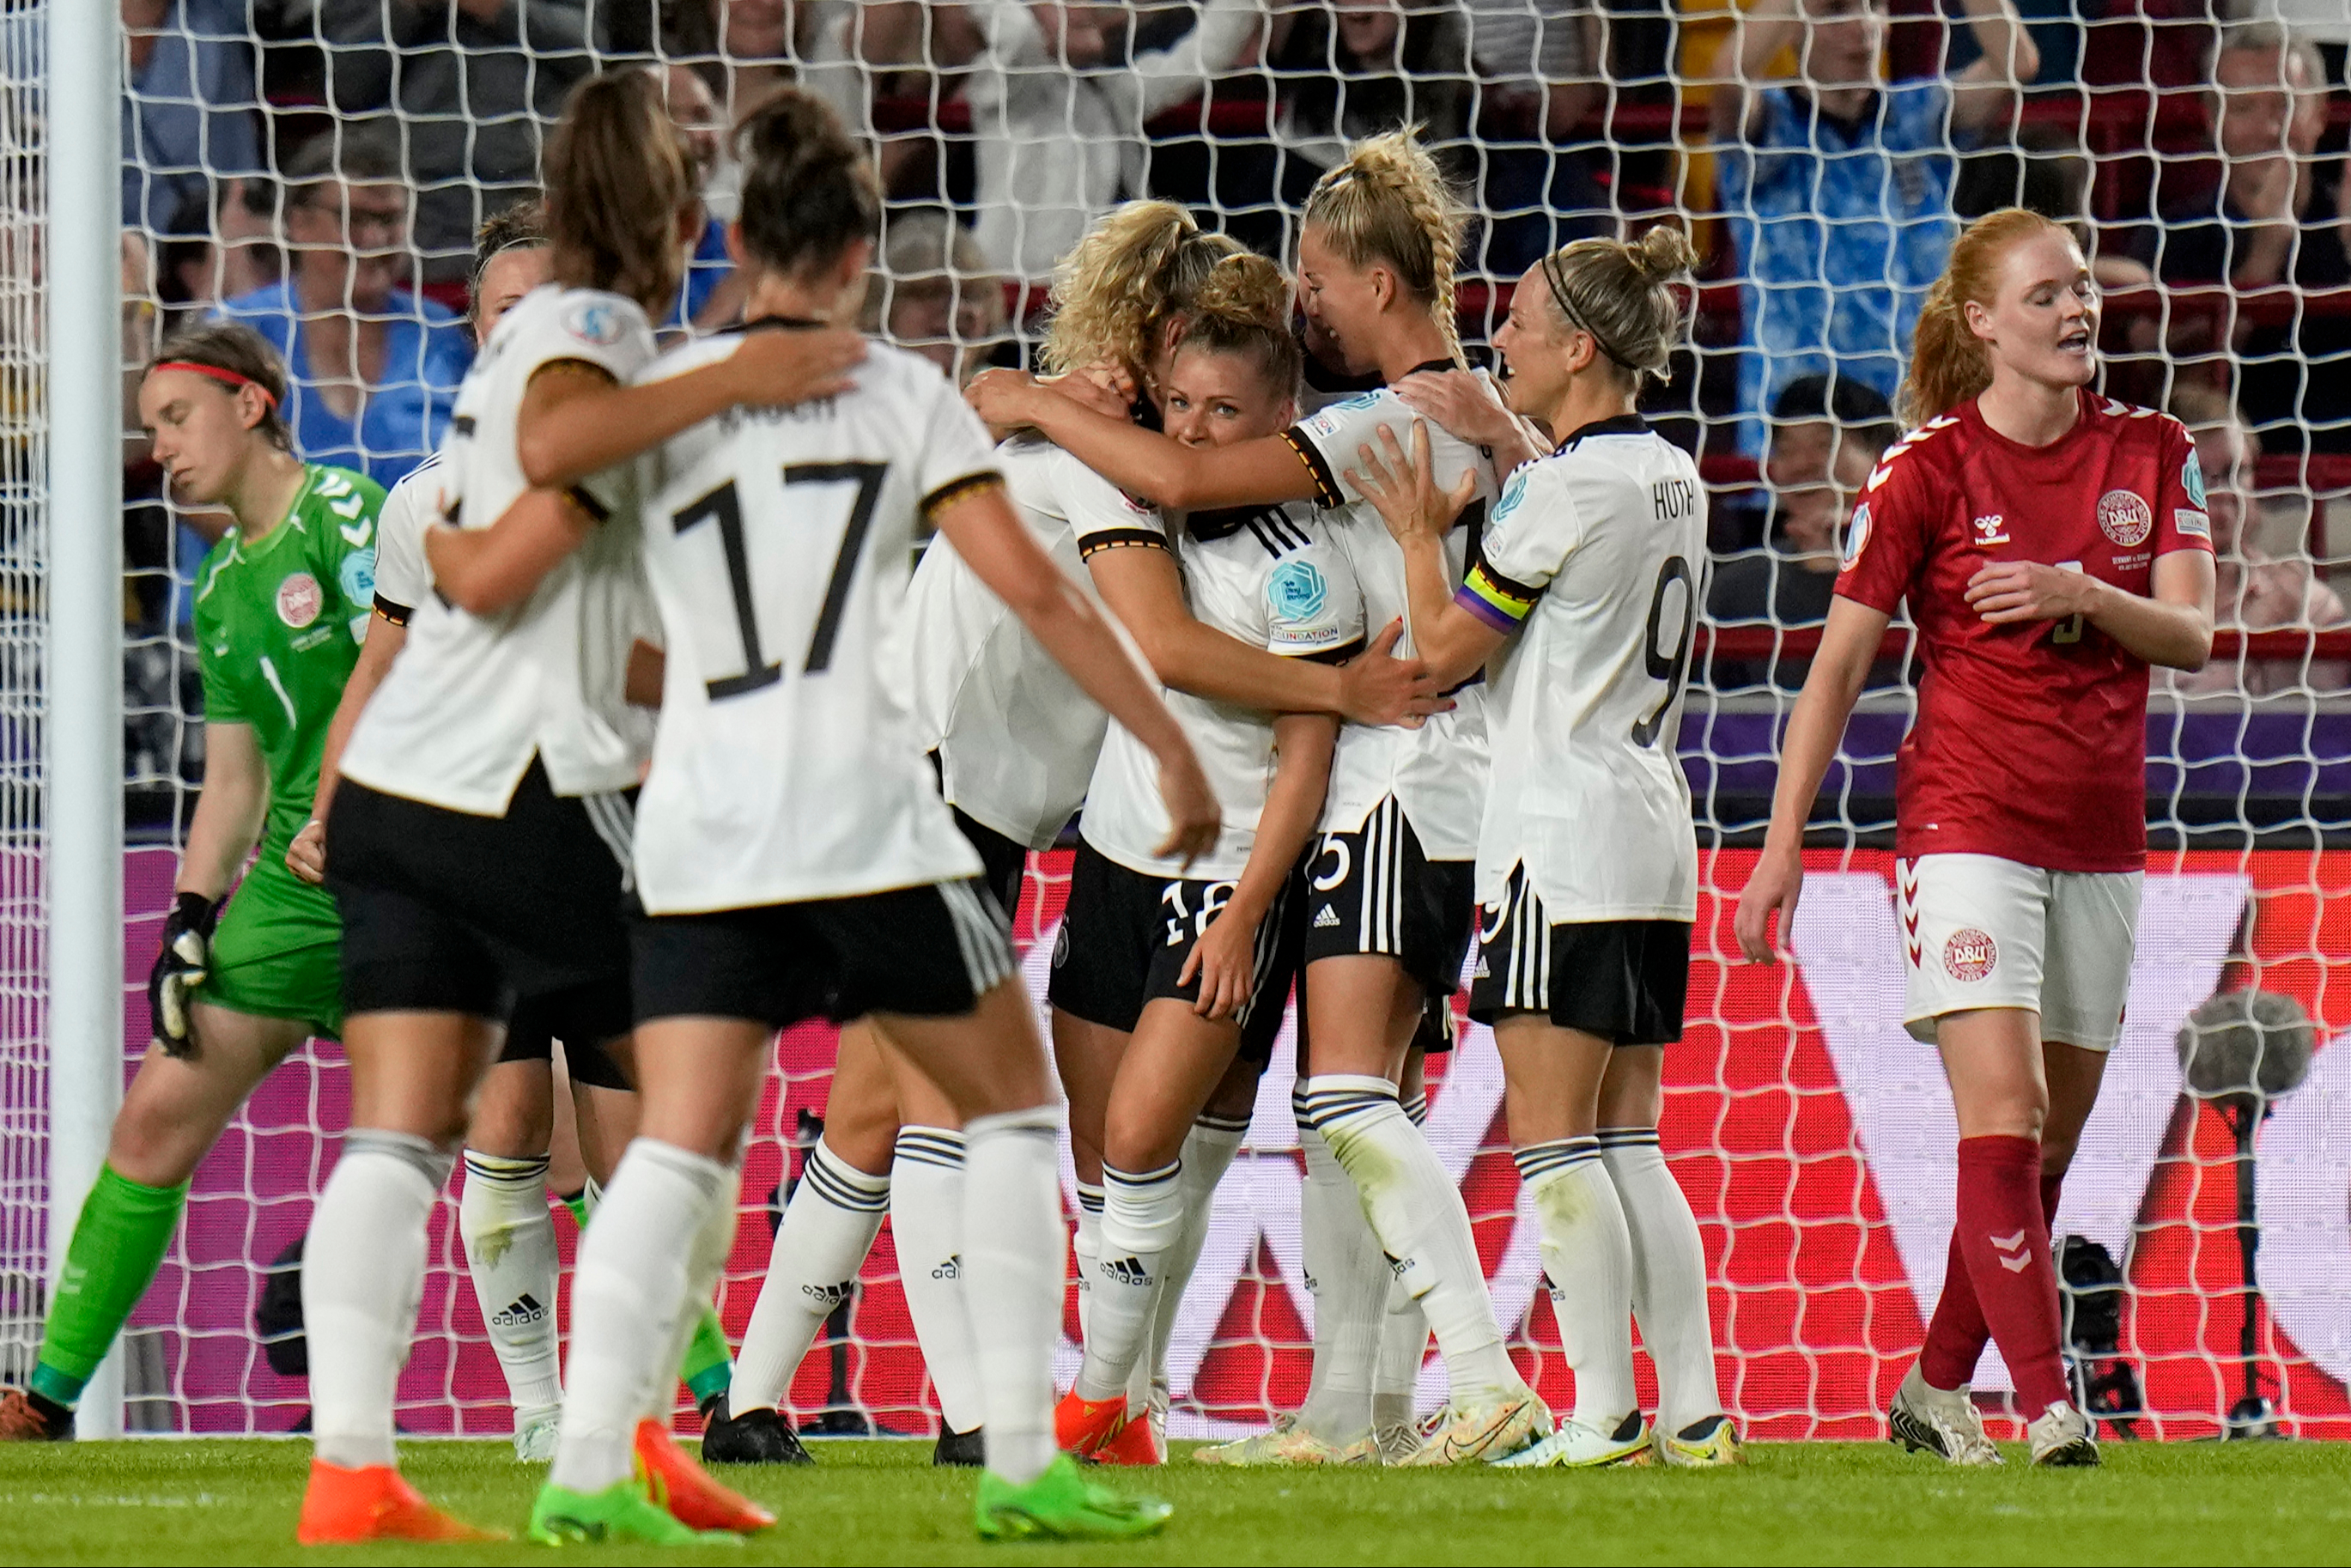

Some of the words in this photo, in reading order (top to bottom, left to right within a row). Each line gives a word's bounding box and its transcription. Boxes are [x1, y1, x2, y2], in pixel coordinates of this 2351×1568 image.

[1653, 478, 1694, 520] HUTH
[2108, 507, 2140, 526] DBU
[673, 462, 891, 701] 17
[1272, 627, 1338, 641] FOUNDATION
[1631, 556, 1692, 747] 9
[259, 656, 296, 729] 1
[1954, 945, 1986, 964] DBU
[1100, 1261, 1152, 1286] adidas
[492, 1306, 549, 1326] adidas
